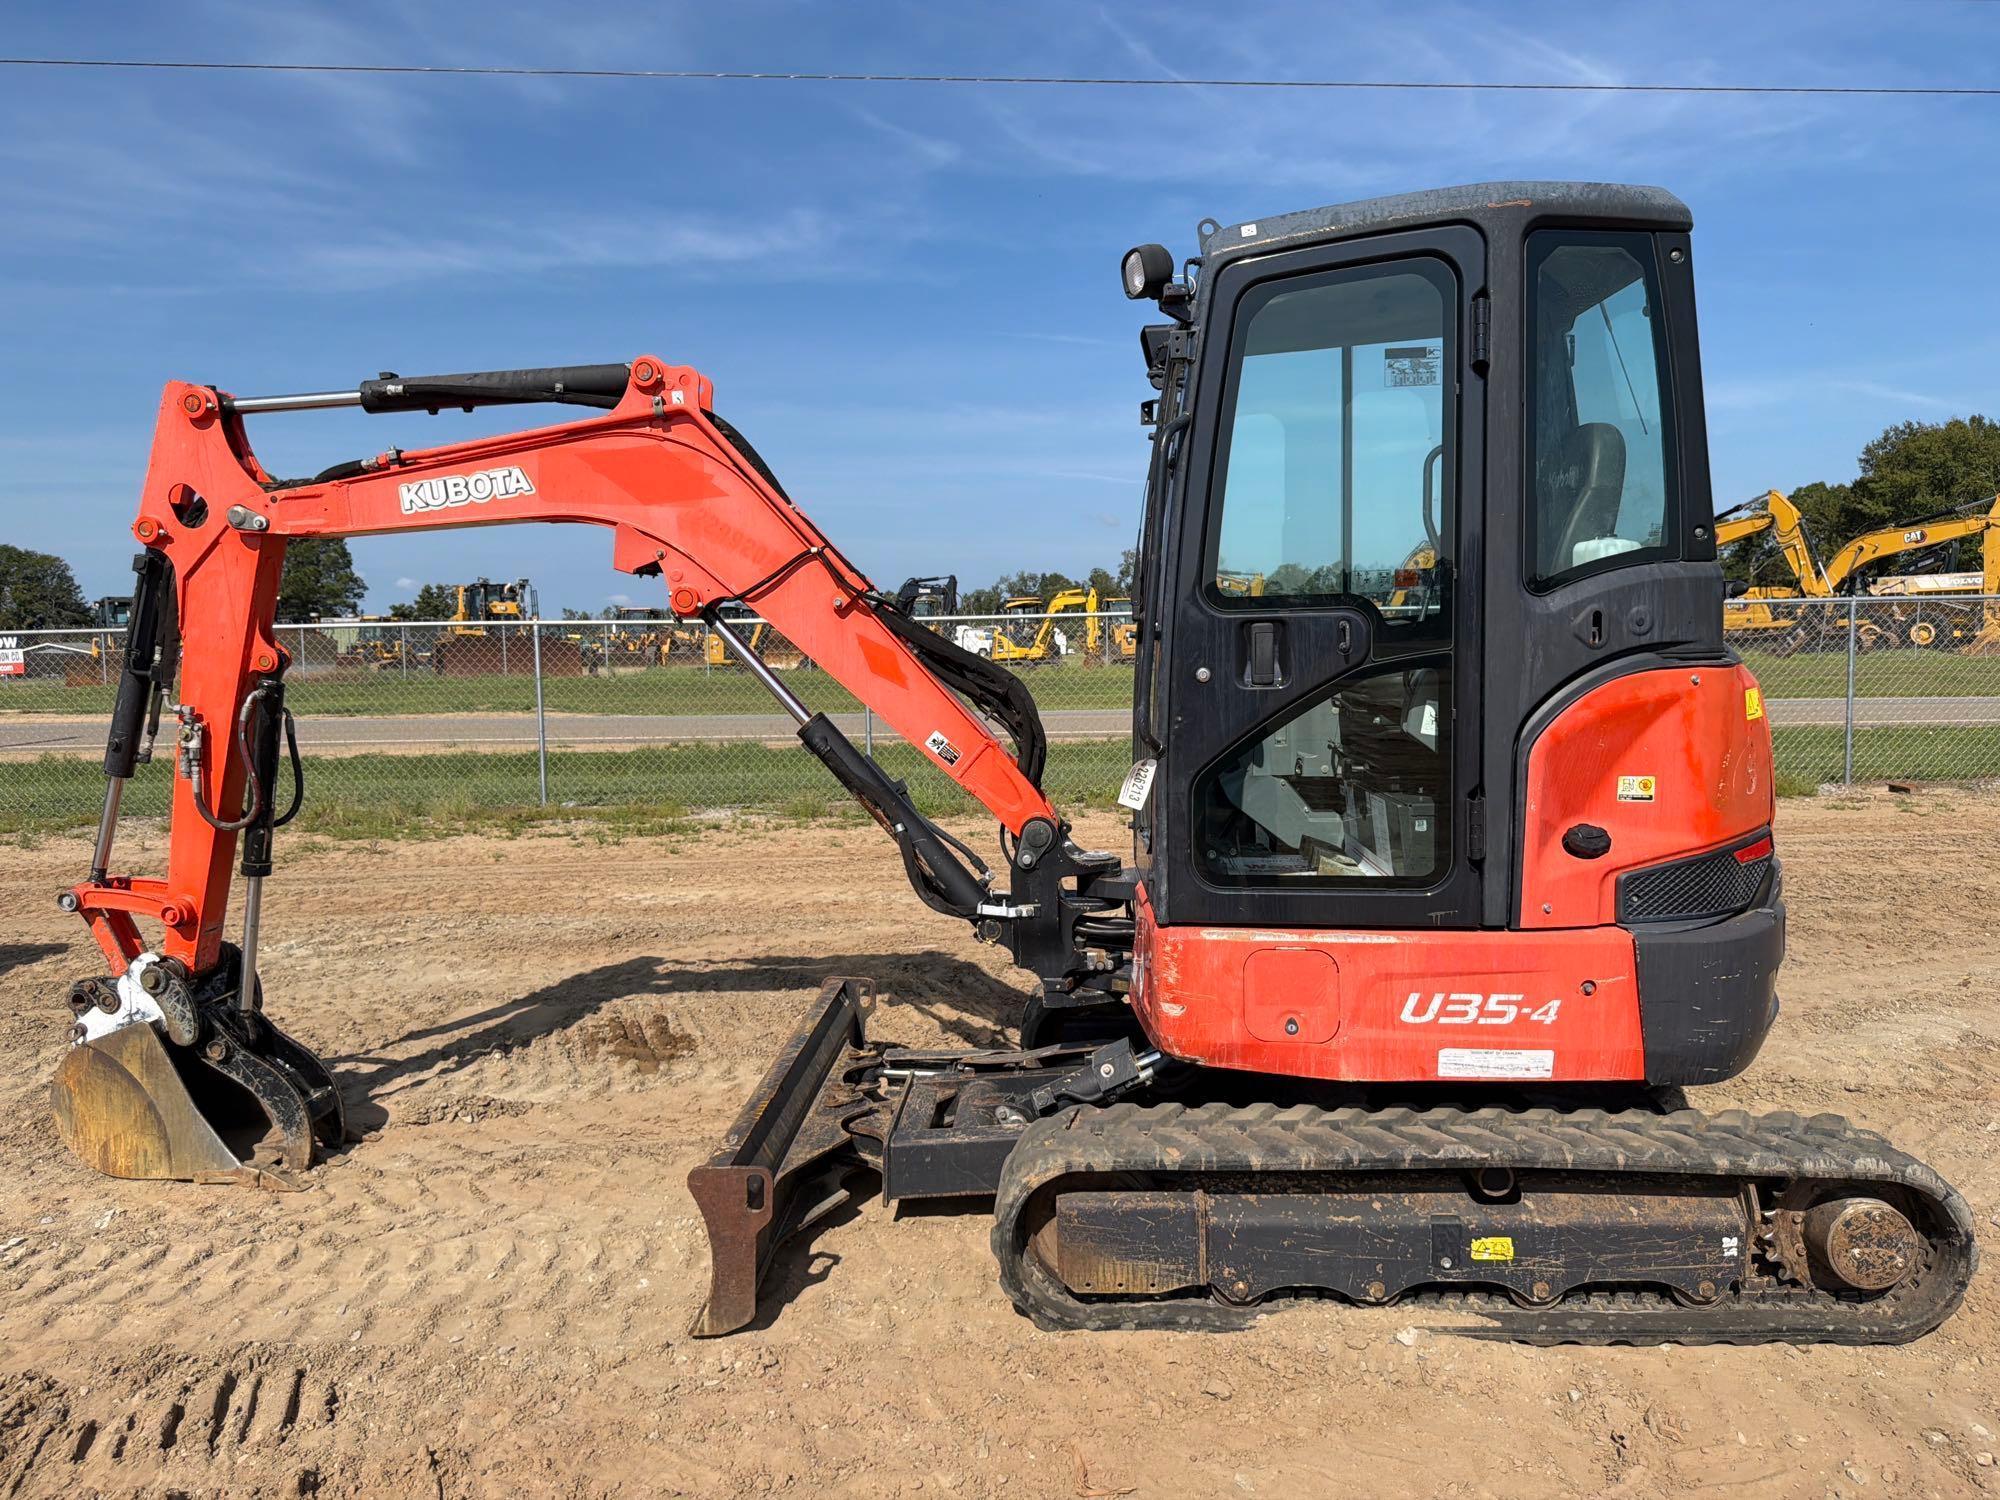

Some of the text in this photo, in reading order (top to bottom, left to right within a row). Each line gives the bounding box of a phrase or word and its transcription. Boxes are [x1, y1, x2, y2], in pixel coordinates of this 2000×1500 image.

[400, 466, 534, 512] KUBOTA
[1904, 530, 1922, 543] CAT
[1128, 767, 1149, 802] 226213
[1400, 992, 1562, 1025] U35-4
